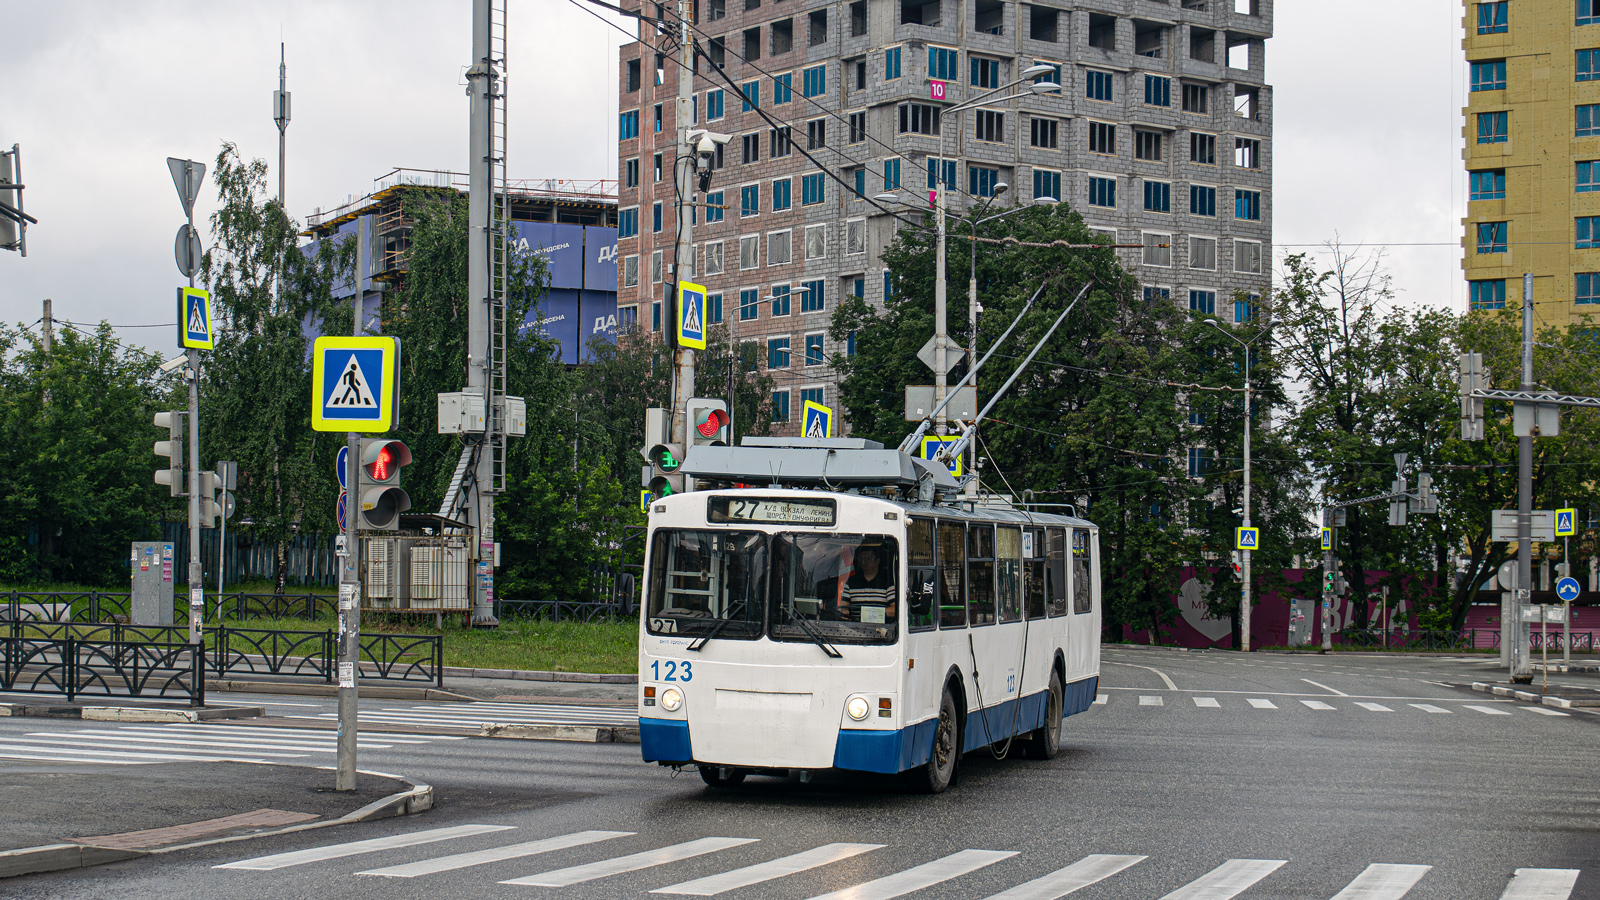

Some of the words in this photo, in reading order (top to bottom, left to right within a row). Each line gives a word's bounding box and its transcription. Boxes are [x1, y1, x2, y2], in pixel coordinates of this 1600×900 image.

[932, 84, 943, 97] 10
[593, 313, 617, 334] ДА
[734, 500, 760, 519] 27
[764, 504, 777, 512] Ж/Д
[653, 619, 675, 633] 27
[651, 660, 693, 682] 123
[1007, 674, 1015, 692] 123
